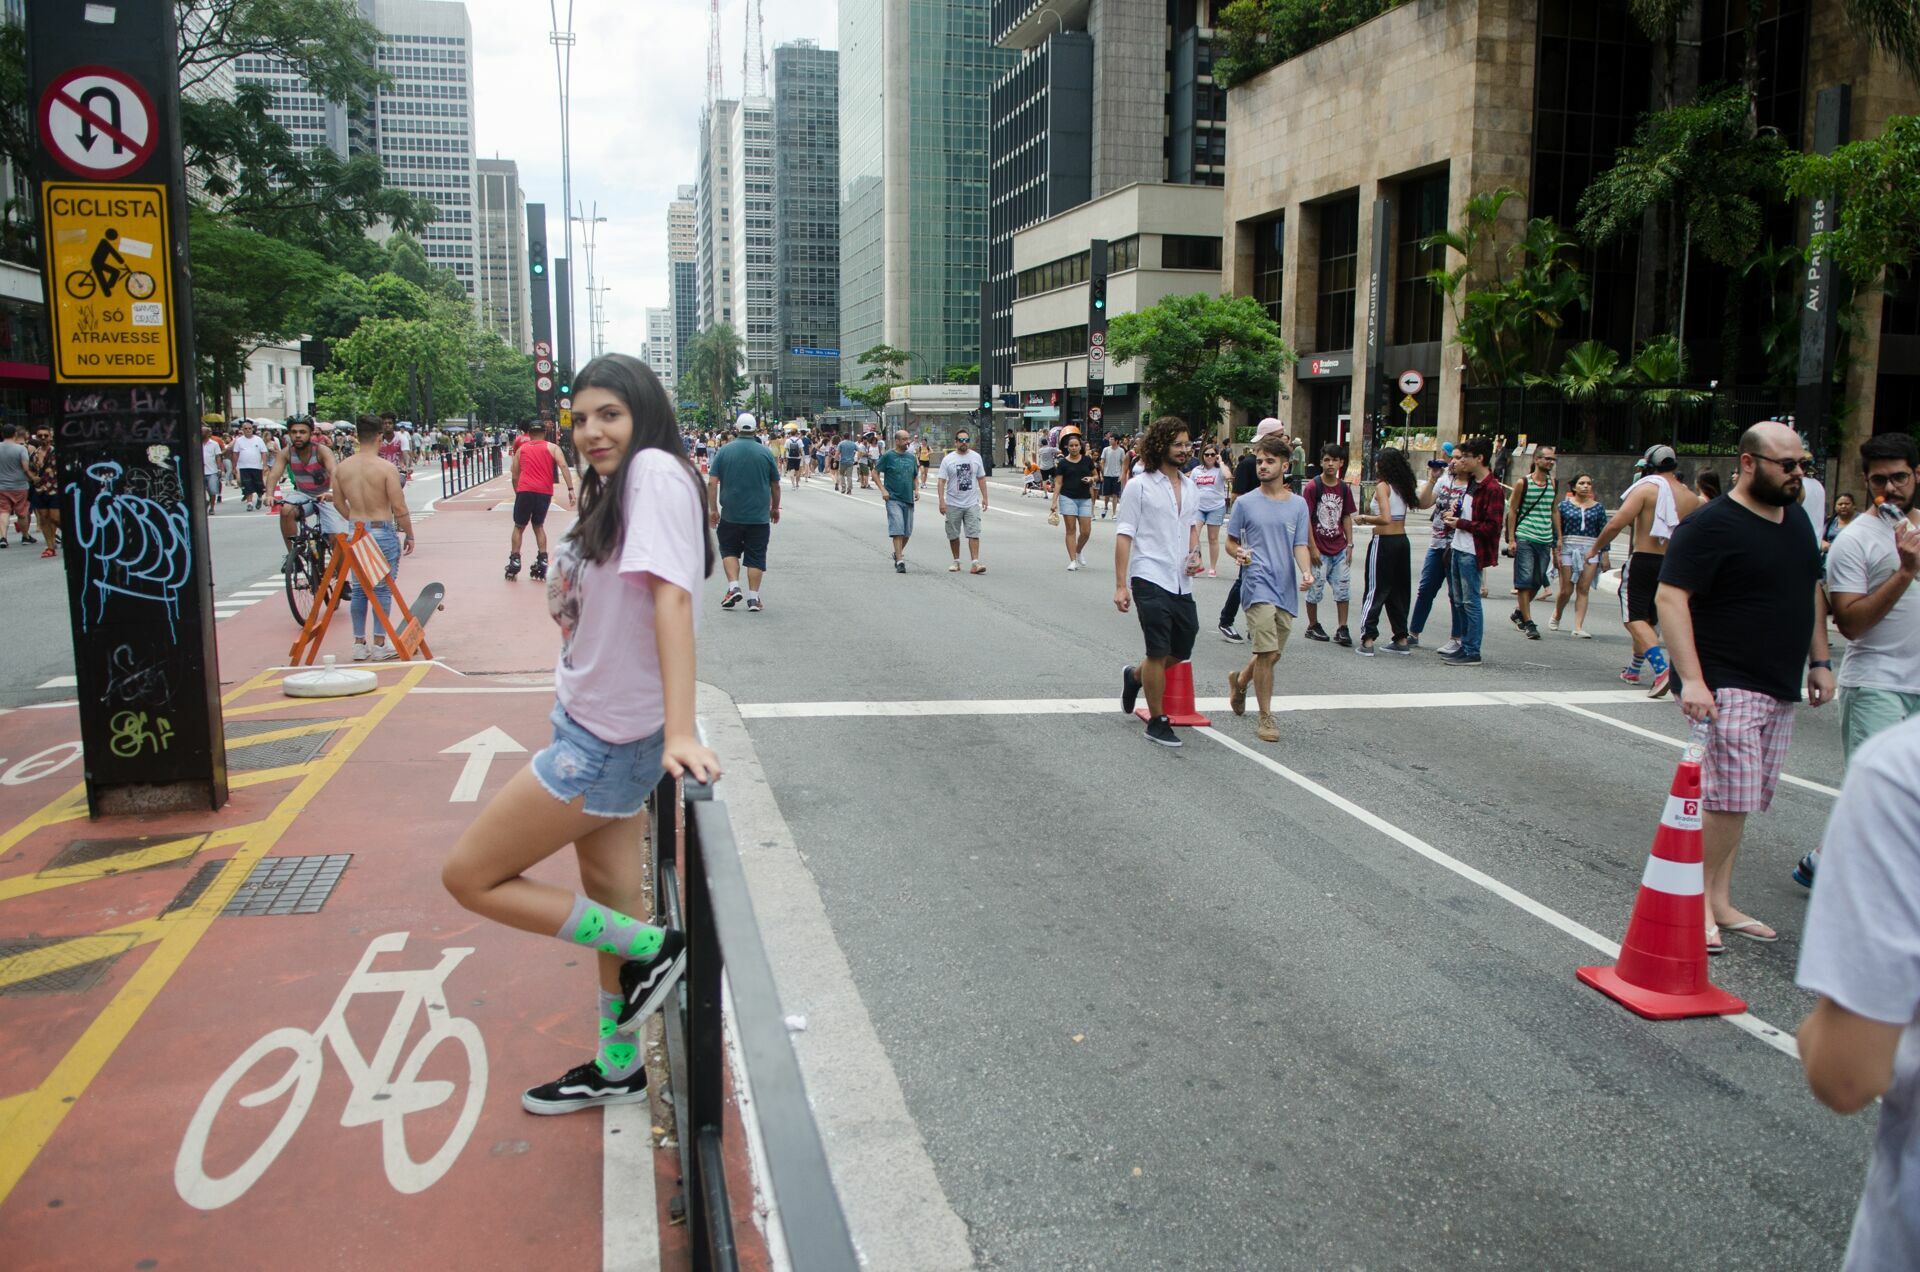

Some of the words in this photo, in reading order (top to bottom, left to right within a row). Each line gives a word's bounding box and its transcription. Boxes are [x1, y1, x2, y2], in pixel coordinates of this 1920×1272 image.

[53, 199, 157, 218] CICLISTA
[1808, 200, 1825, 280] Paista
[1369, 273, 1378, 326] Paulista
[1806, 286, 1819, 311] Av.
[103, 307, 124, 322] SÓ
[72, 332, 160, 344] ATRAVESSE
[77, 353, 100, 366] NO
[104, 354, 156, 366] VERDE
